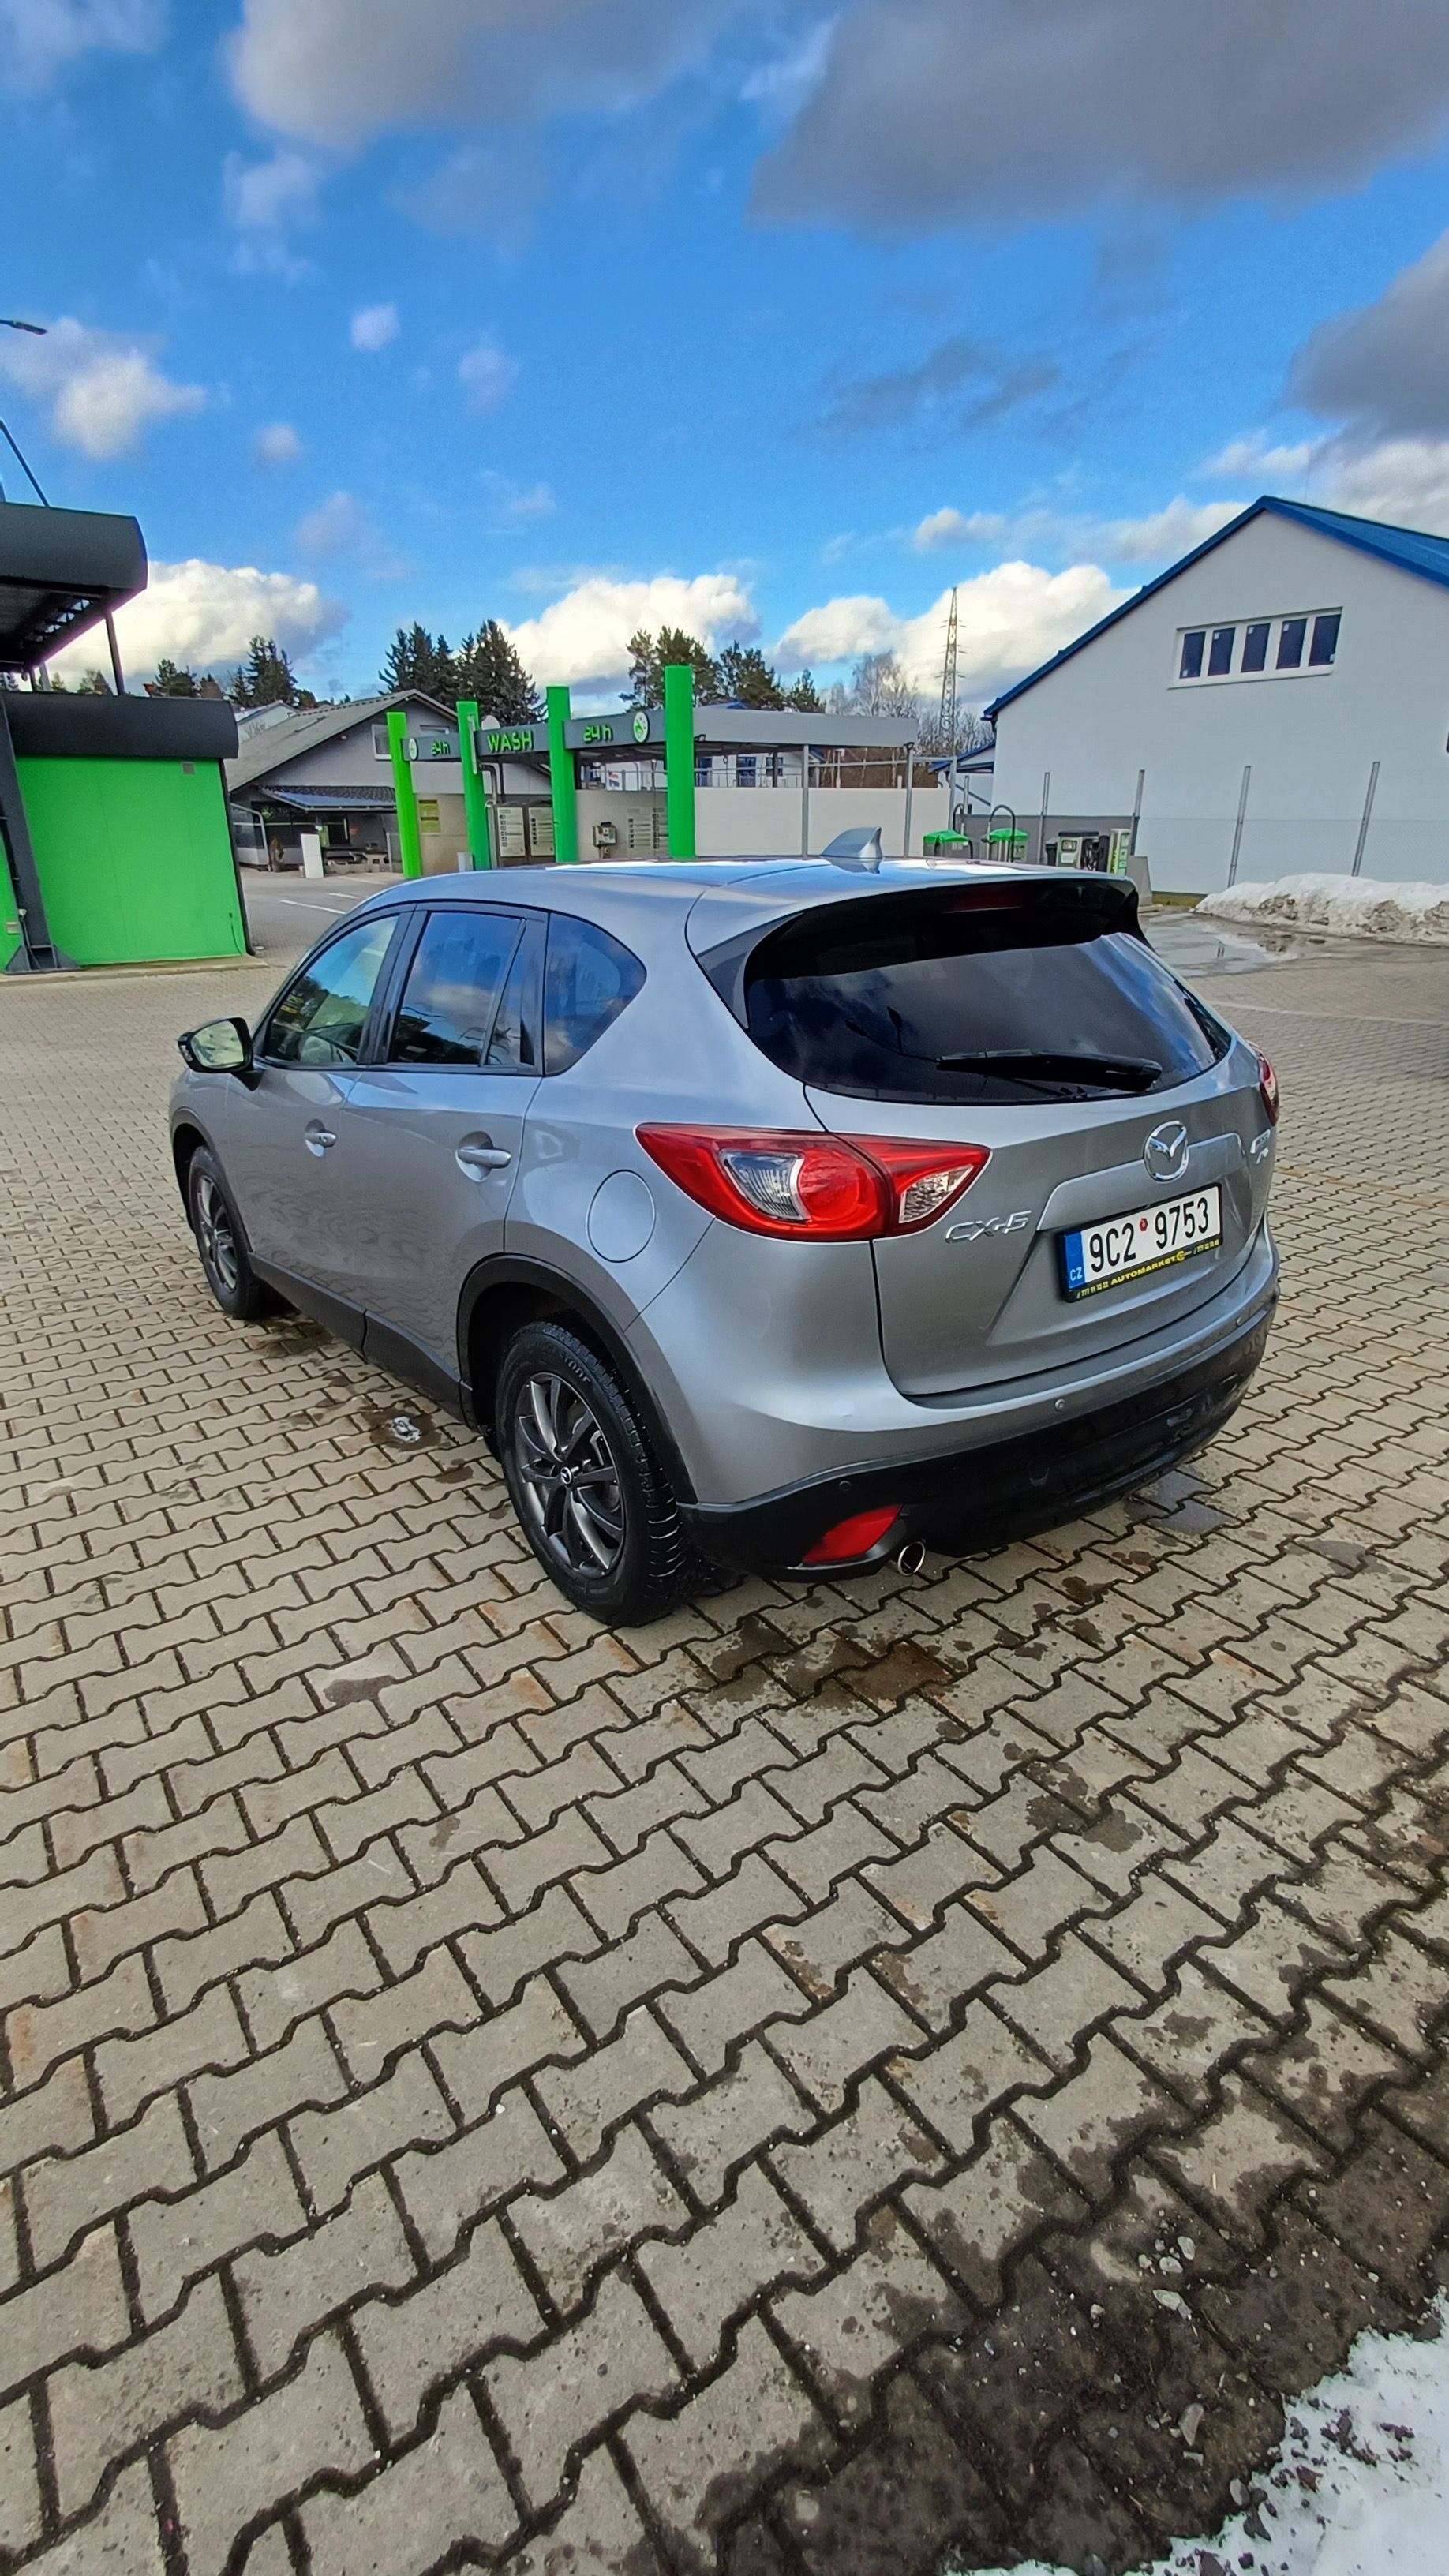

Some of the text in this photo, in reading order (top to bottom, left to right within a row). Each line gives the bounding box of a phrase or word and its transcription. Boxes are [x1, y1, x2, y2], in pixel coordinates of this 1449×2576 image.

[487, 731, 533, 753] WASH
[945, 1210, 1032, 1243] CX-5
[1089, 1197, 1209, 1273] 9C2 9753
[1069, 1267, 1083, 1282] CZ
[1110, 1256, 1178, 1286] AUTOMARKET
